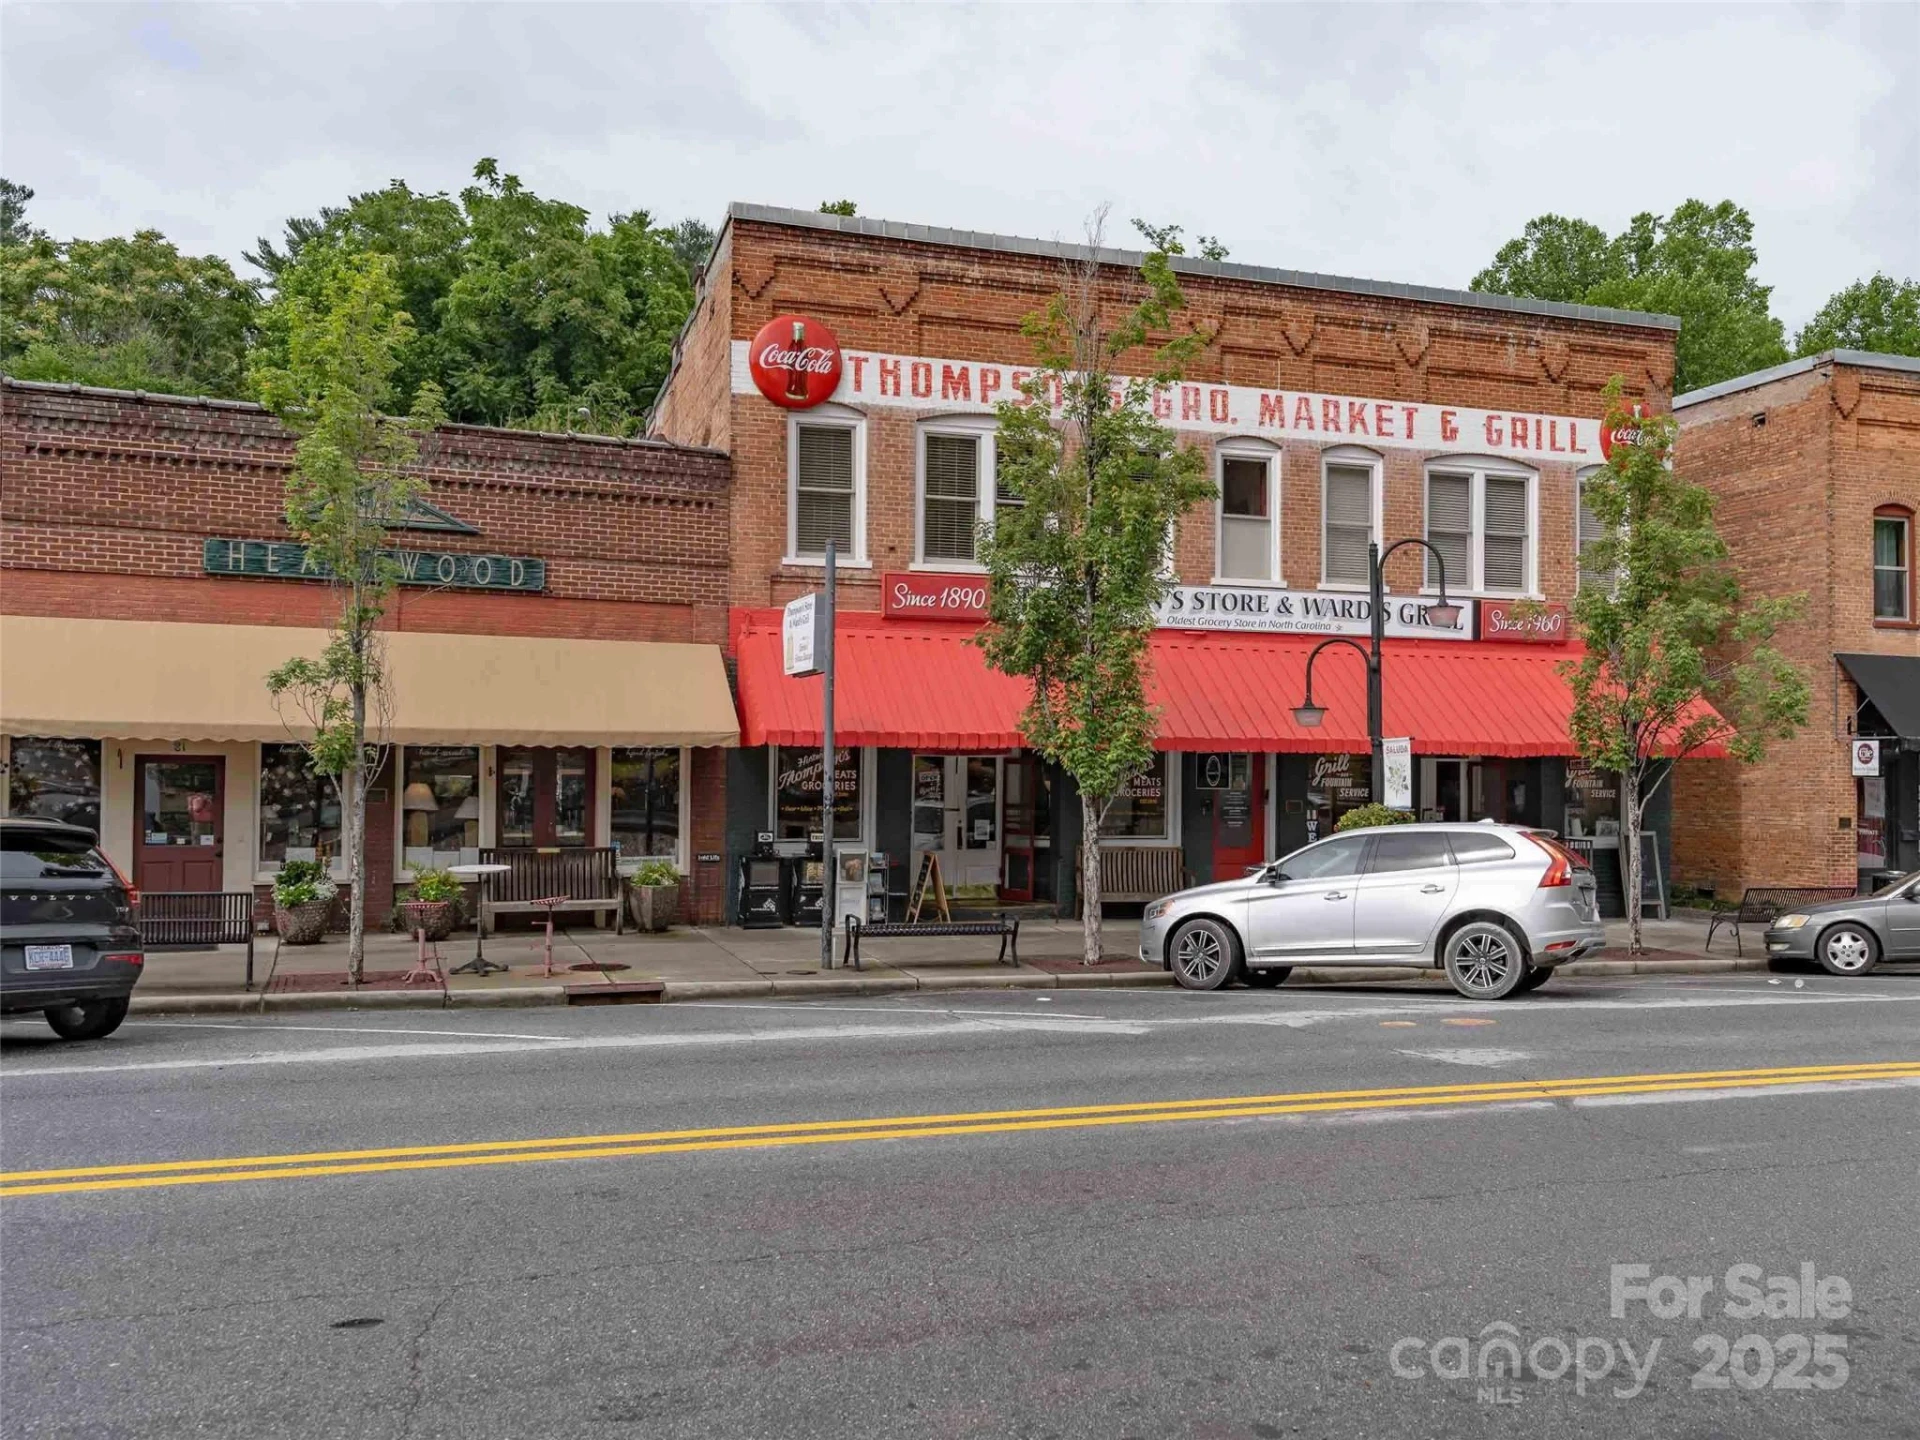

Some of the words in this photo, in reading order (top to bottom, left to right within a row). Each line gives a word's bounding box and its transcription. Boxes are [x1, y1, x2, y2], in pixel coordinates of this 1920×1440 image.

[759, 343, 834, 375] Coca-Cola
[1259, 393, 1419, 440] MARKET
[1440, 410, 1459, 442] &
[1485, 414, 1588, 455] GRILL
[228, 541, 525, 587] HEAWOOD
[892, 583, 936, 609] Since
[940, 586, 986, 610] 1890
[1192, 591, 1270, 614] STORE
[1277, 596, 1294, 615] &
[1302, 596, 1391, 622] WARDS
[1166, 615, 1196, 626] Oldest
[1197, 617, 1232, 629] Grocery
[1233, 618, 1257, 628] Store
[1258, 619, 1267, 628] in
[1269, 620, 1294, 630] North
[1295, 620, 1331, 631] Carolina
[1489, 609, 1523, 633] Since
[1385, 745, 1409, 755] SALUDA
[1134, 777, 1161, 787] MEATS
[1312, 754, 1350, 786] Grill
[801, 781, 856, 791] GRORIES
[1340, 788, 1370, 798] SERVICE
[1590, 789, 1616, 798] SERVICE
